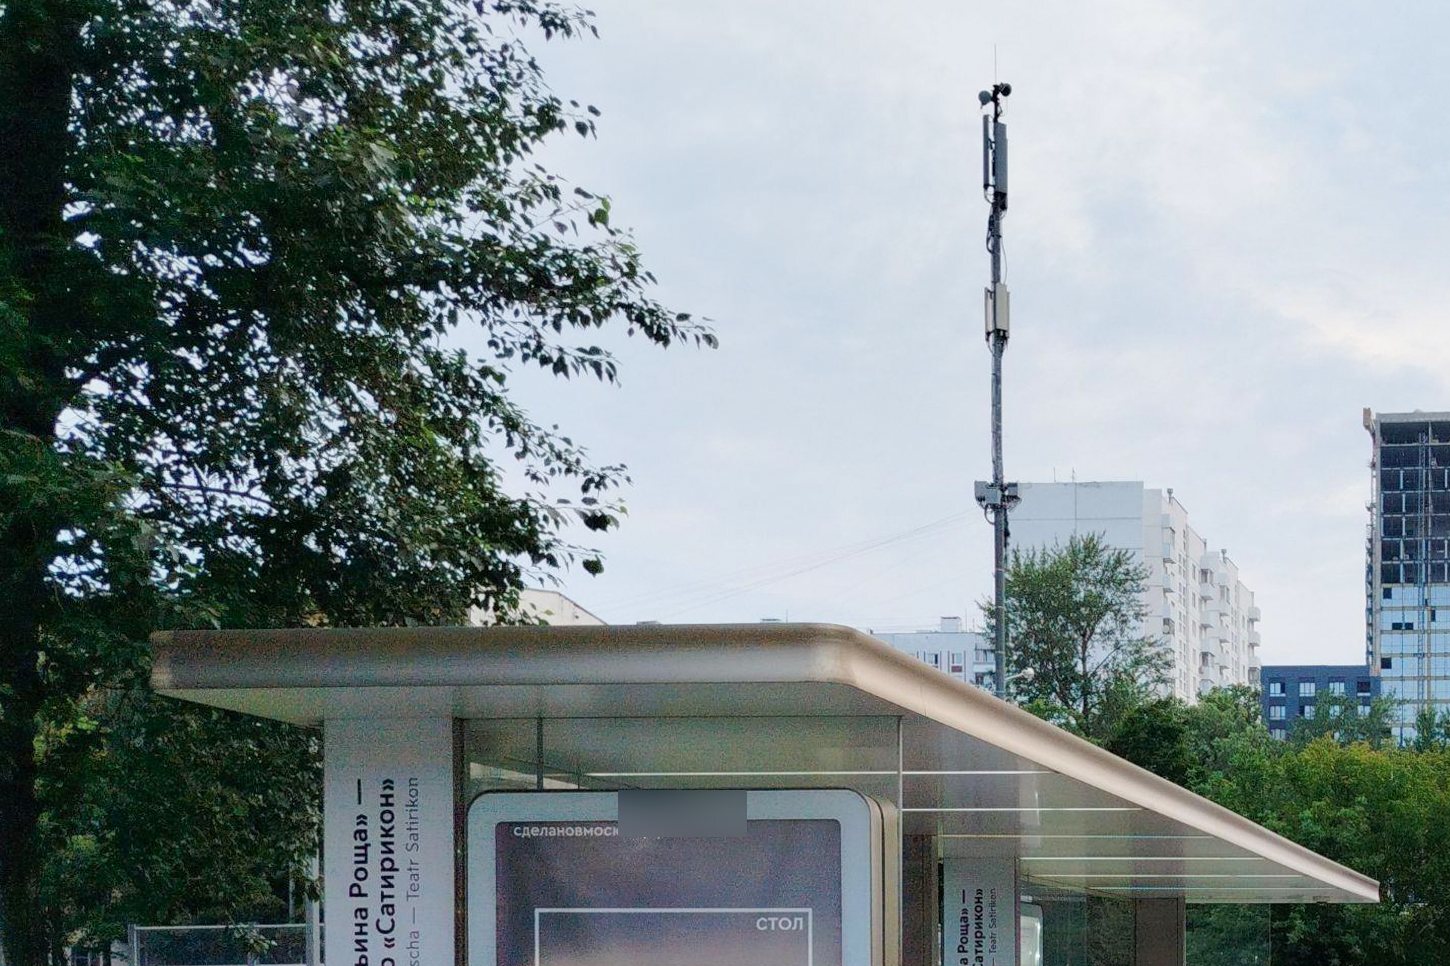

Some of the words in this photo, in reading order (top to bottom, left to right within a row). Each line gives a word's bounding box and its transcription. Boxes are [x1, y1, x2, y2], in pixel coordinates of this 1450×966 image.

[405, 777, 420, 852] Satirikon
[348, 813, 371, 898] Роща»
[375, 778, 400, 949] «Сатирикон»
[406, 859, 420, 901] Teatr
[756, 917, 803, 930] СТОЛ
[989, 888, 997, 928] Satirikon
[957, 908, 970, 953] Роща»
[989, 932, 997, 954] Teatr
